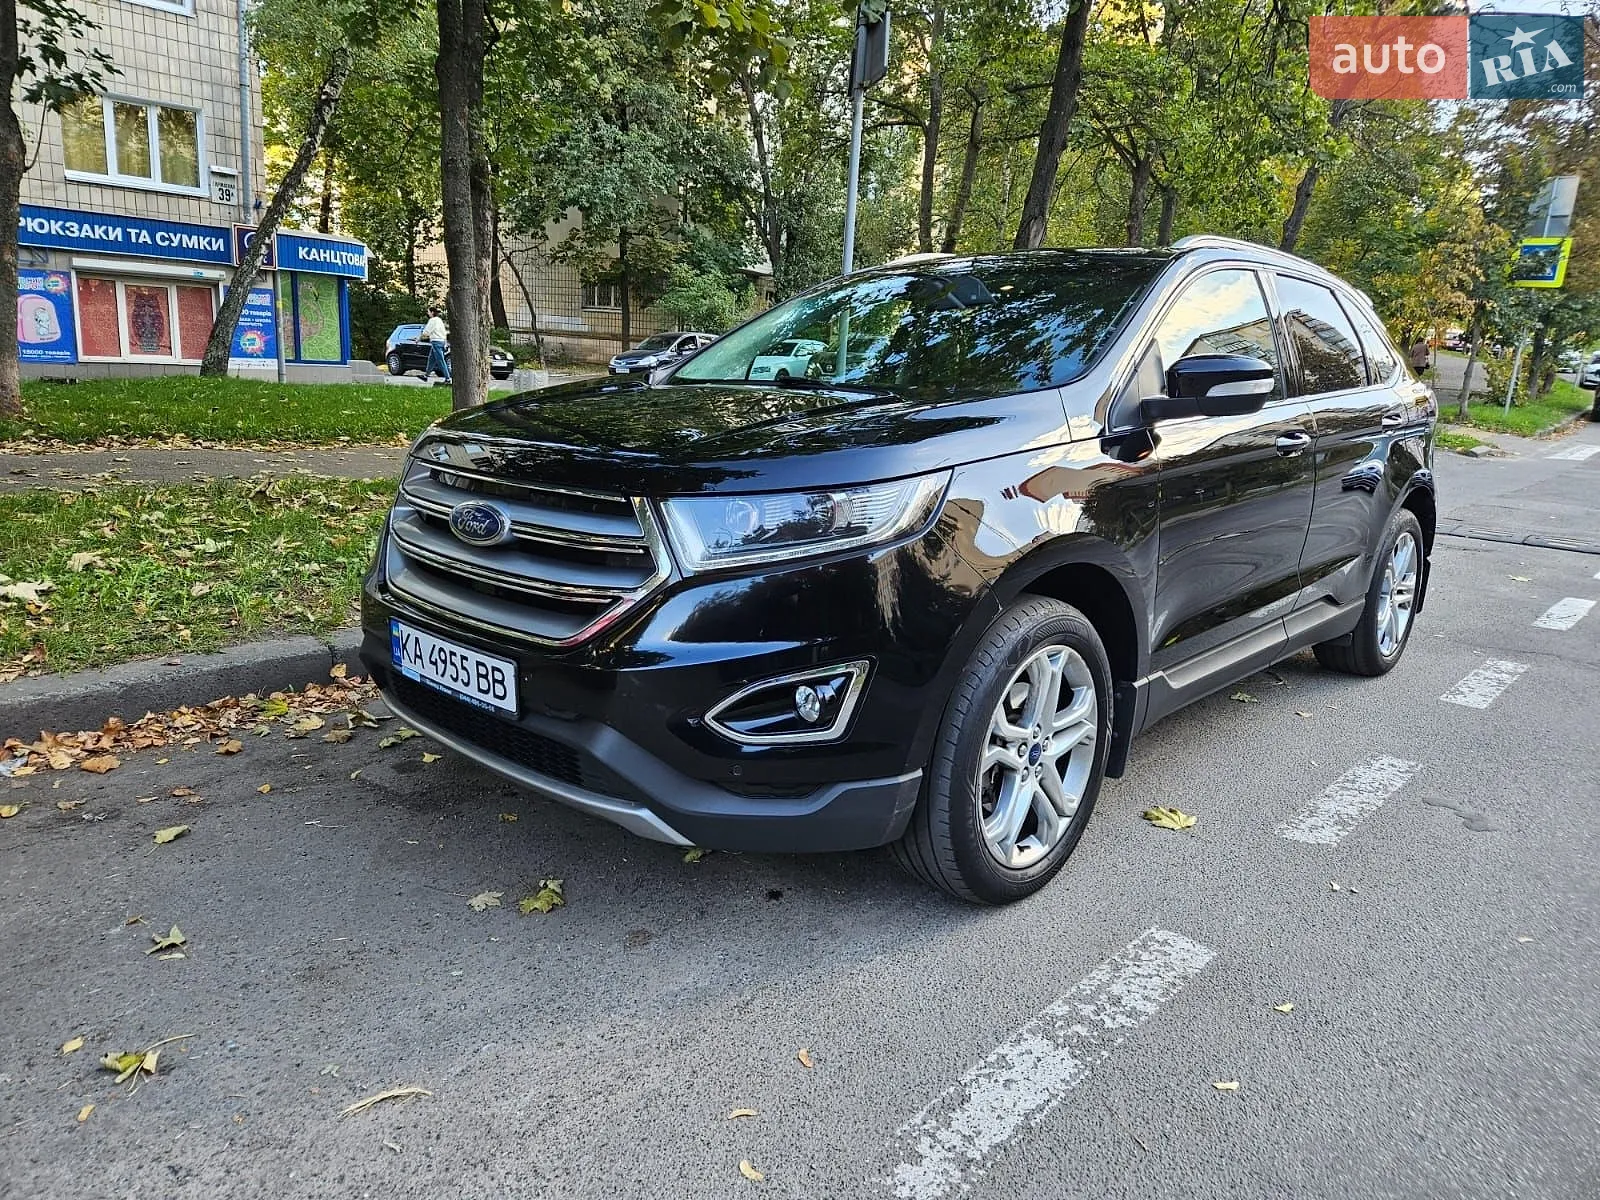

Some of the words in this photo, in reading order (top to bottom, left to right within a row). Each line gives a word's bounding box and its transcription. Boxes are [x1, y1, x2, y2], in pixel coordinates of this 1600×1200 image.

[127, 228, 153, 245] ТА
[155, 231, 225, 252] СУМКИ
[457, 508, 491, 535] Ford
[400, 629, 425, 669] KA
[428, 644, 471, 688] 4955
[475, 660, 508, 701] BB
